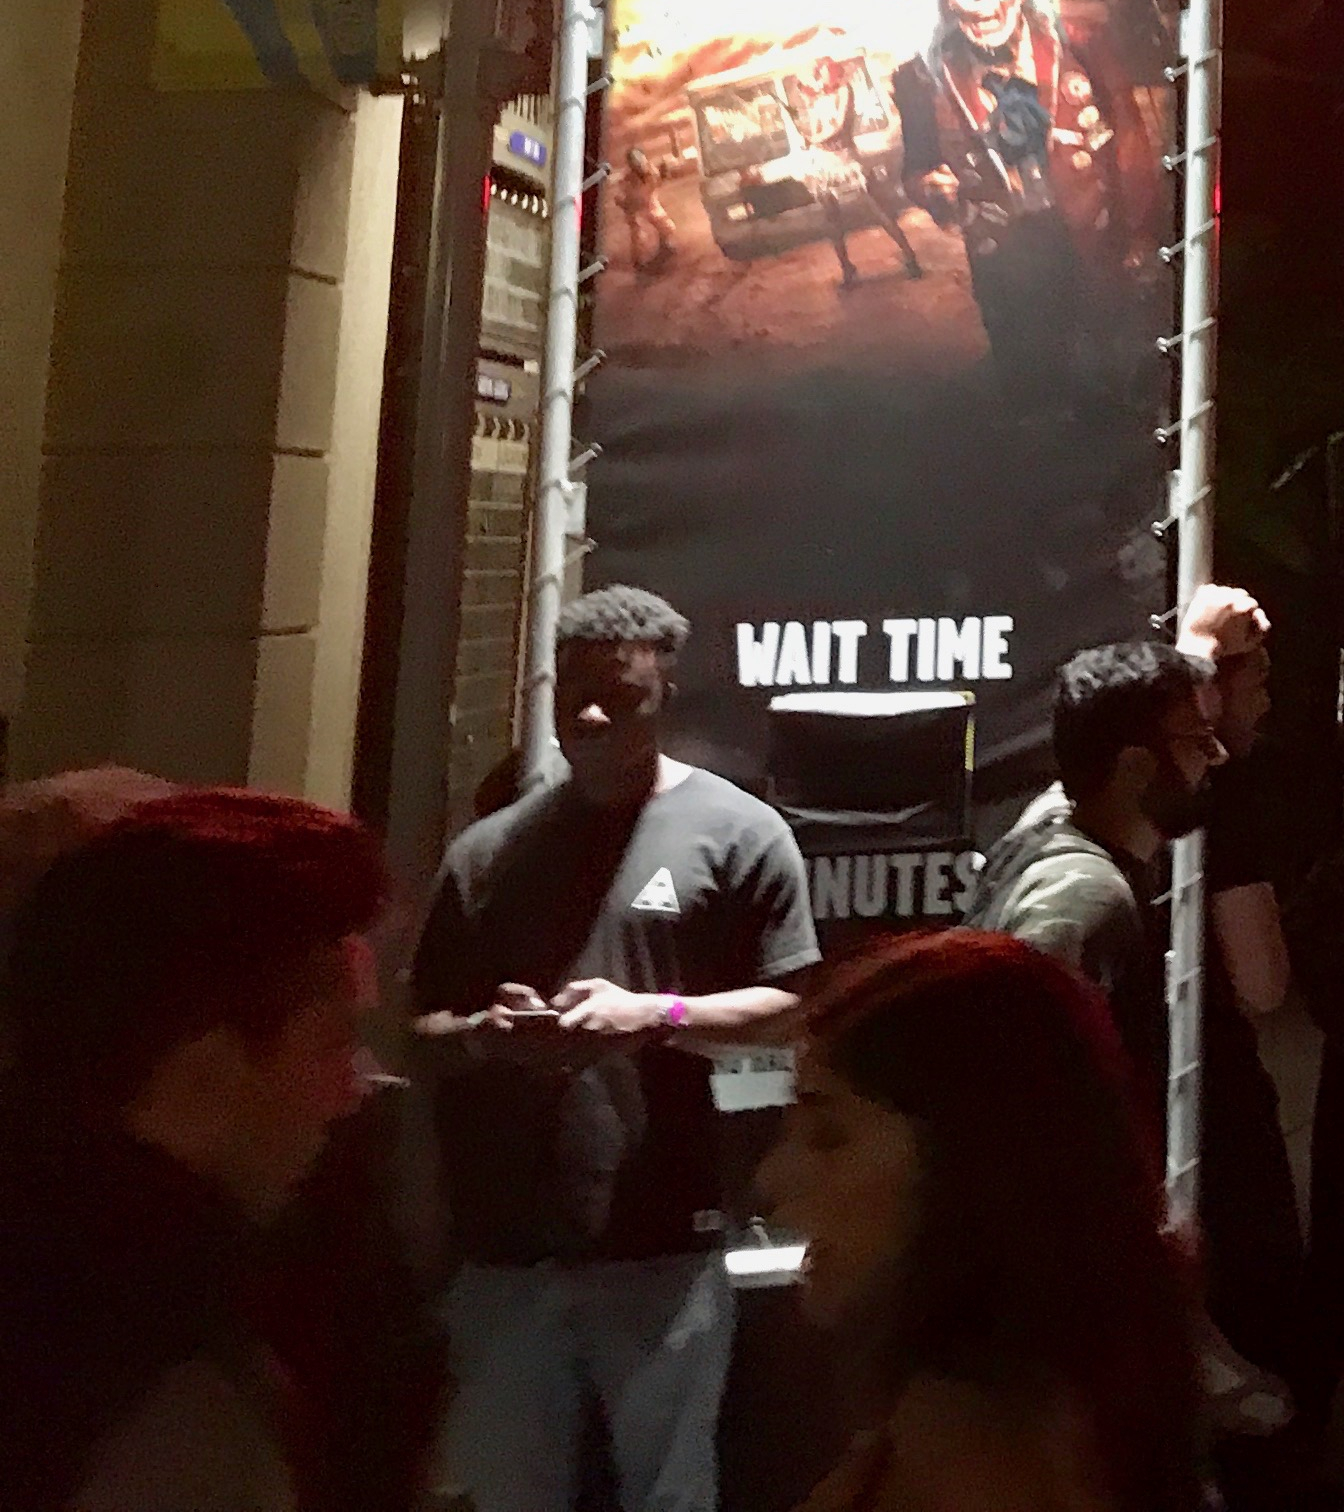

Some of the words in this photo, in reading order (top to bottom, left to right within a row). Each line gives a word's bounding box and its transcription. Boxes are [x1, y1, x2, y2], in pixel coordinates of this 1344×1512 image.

[735, 619, 868, 687] WAIT
[882, 615, 1014, 683] TIME
[806, 851, 980, 919] NUTES
